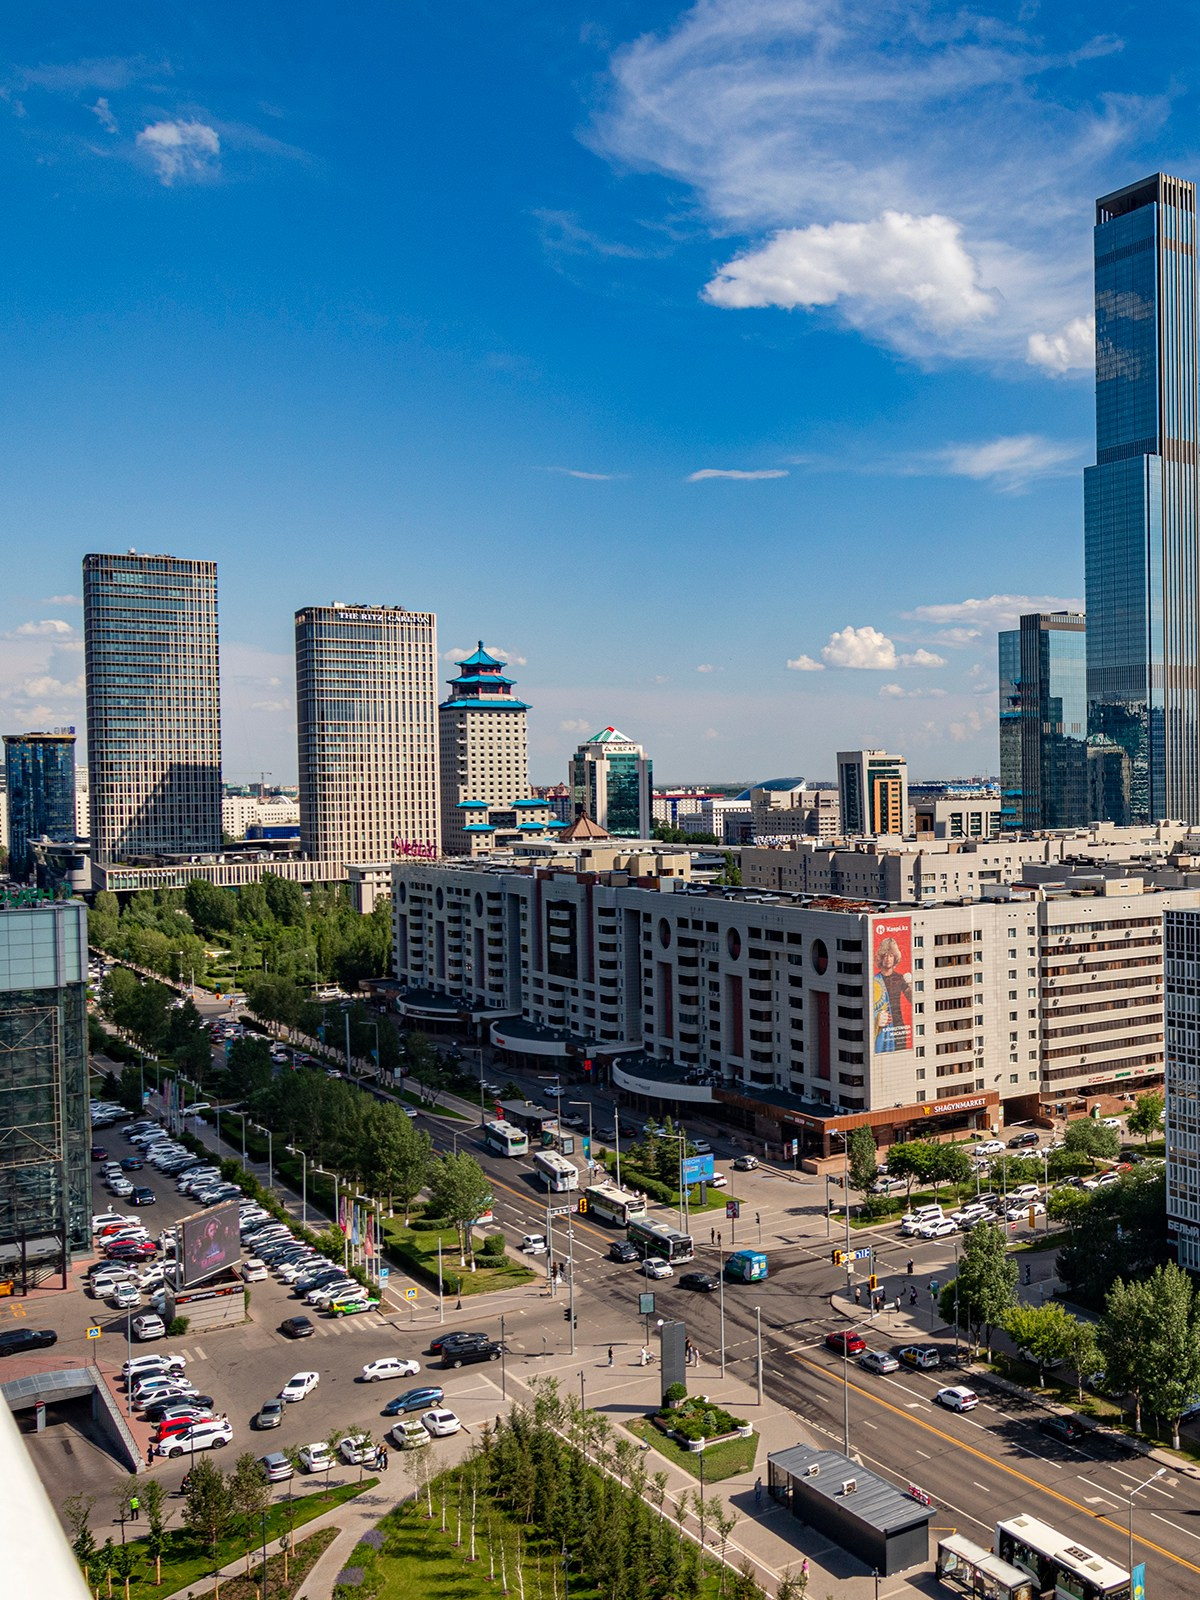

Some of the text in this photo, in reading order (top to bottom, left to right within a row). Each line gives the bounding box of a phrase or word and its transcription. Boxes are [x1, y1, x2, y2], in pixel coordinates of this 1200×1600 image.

[339, 612, 358, 620] THE
[934, 1098, 986, 1113] SHAGYNMARKET
[1168, 1221, 1199, 1238] БЕЛЫЙ
